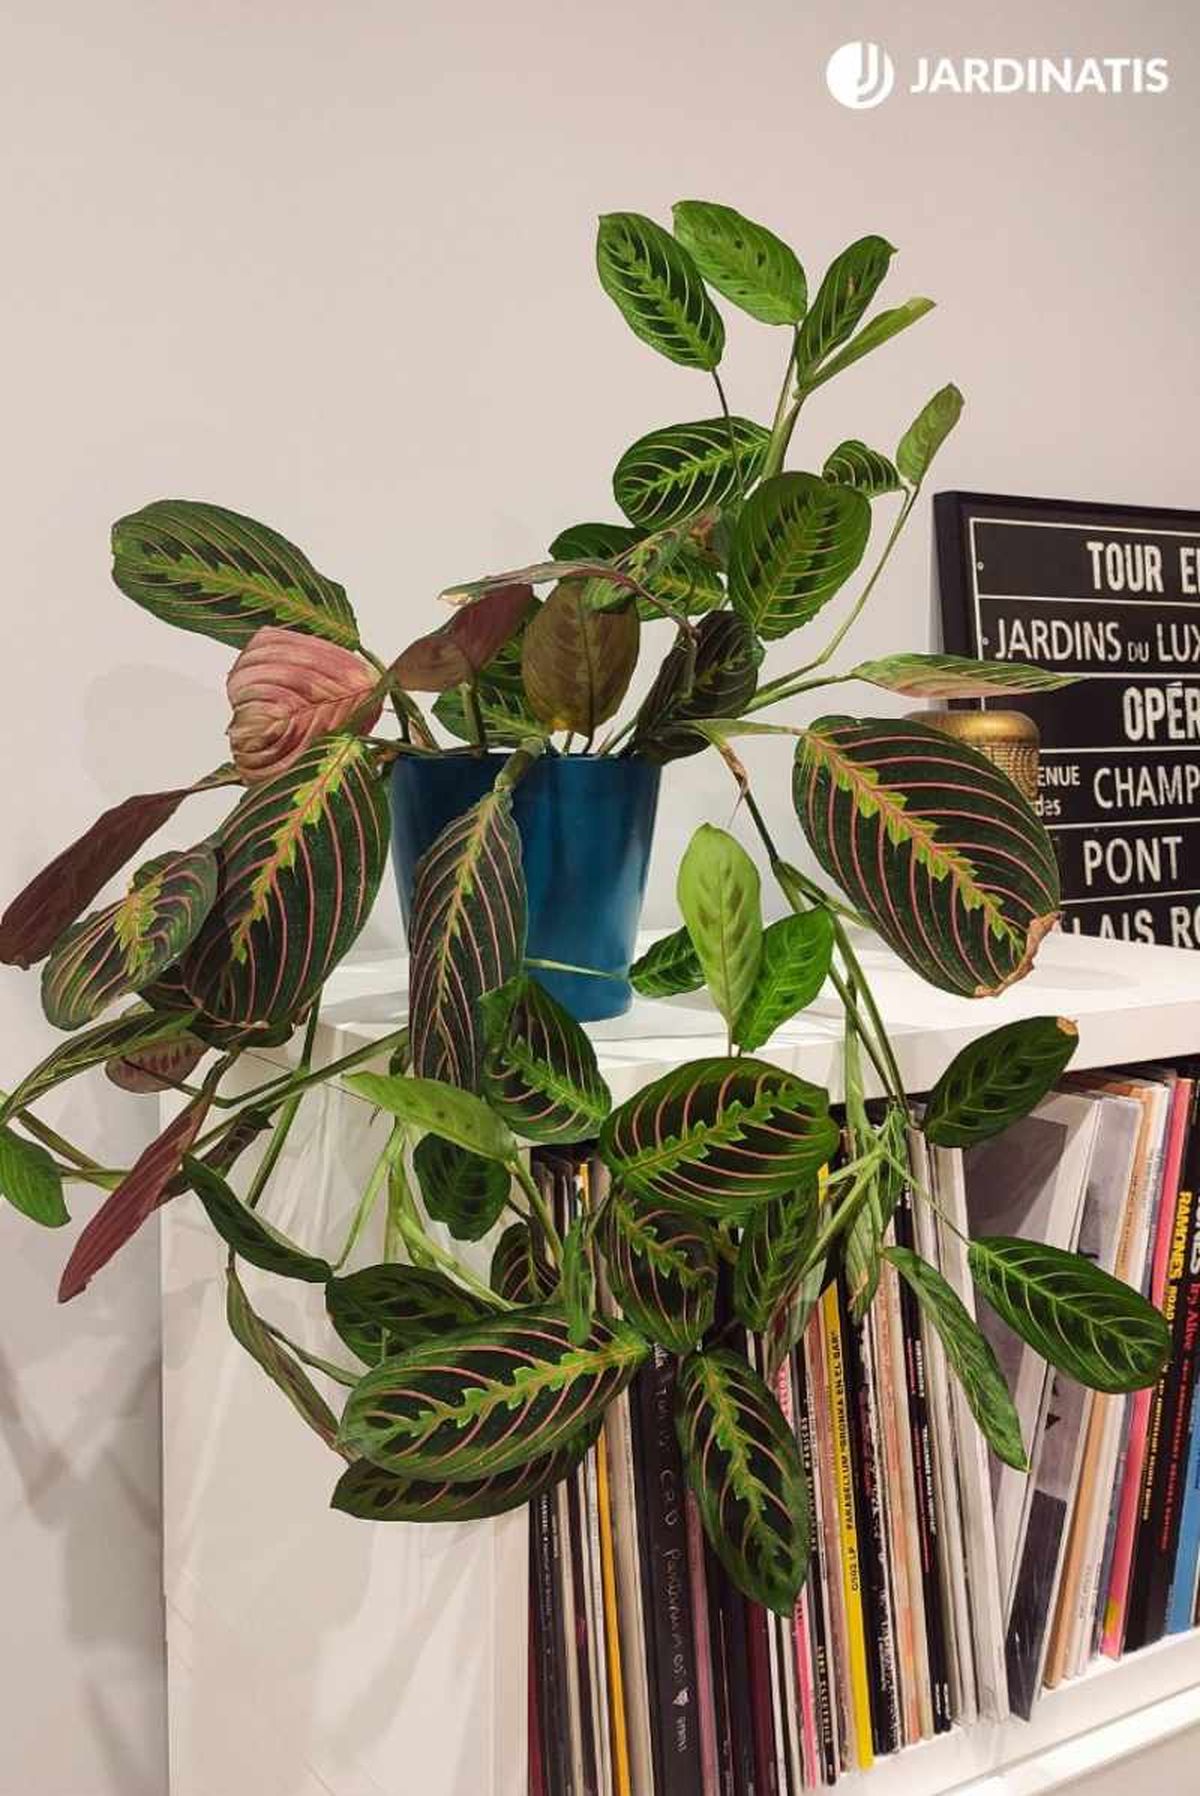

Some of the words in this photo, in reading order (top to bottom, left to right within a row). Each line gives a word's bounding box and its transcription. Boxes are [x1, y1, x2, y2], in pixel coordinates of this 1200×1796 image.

[1087, 541, 1165, 593] TOUR
[995, 618, 1122, 662] JARDINS
[1127, 642, 1150, 662] DU
[1093, 764, 1200, 809] CHAMP
[1083, 836, 1183, 887] PONT
[1168, 1190, 1193, 1280] RAMONES
